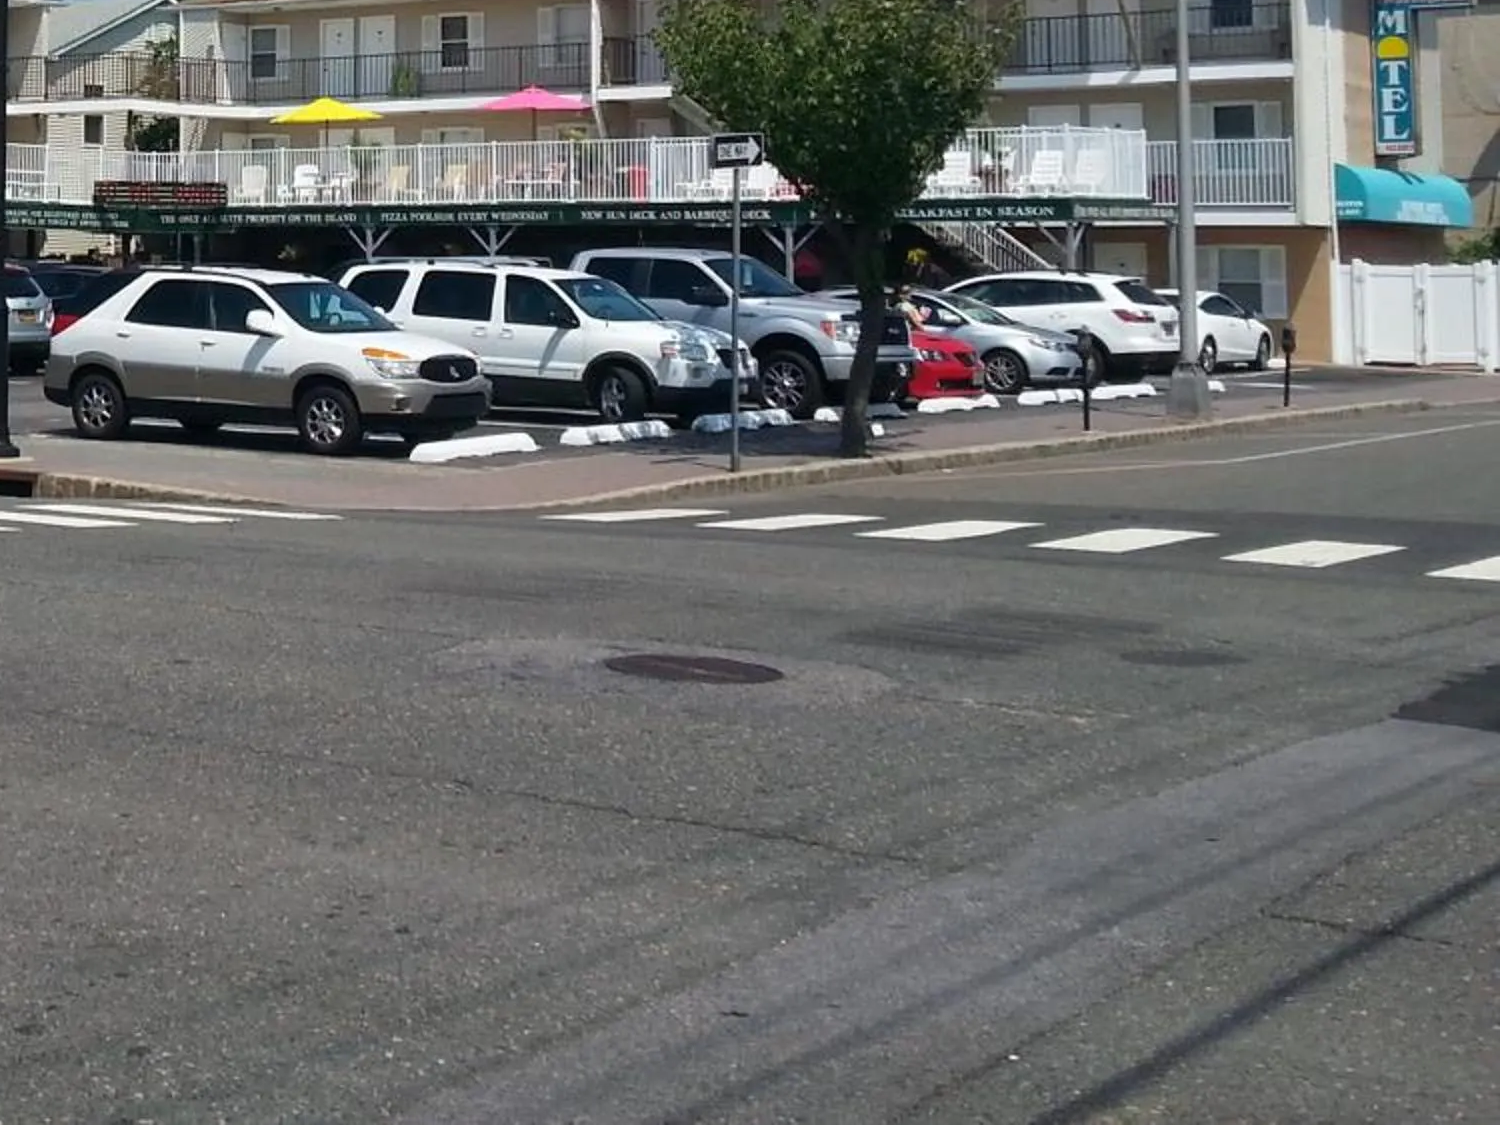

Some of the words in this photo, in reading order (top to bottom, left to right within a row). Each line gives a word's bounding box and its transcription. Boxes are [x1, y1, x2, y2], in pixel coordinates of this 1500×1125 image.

[1377, 10, 1410, 140] MOTEL
[380, 211, 408, 222] PIZZA
[457, 211, 489, 222] EVERY
[491, 210, 549, 221] WEDNESDAY
[581, 210, 604, 220] NEW
[606, 210, 627, 220] SUN
[629, 210, 657, 220] DECK
[660, 209, 682, 220] AND
[683, 209, 732, 222] BARBEQU
[975, 207, 993, 217] IN
[996, 206, 1056, 217] SEASON
